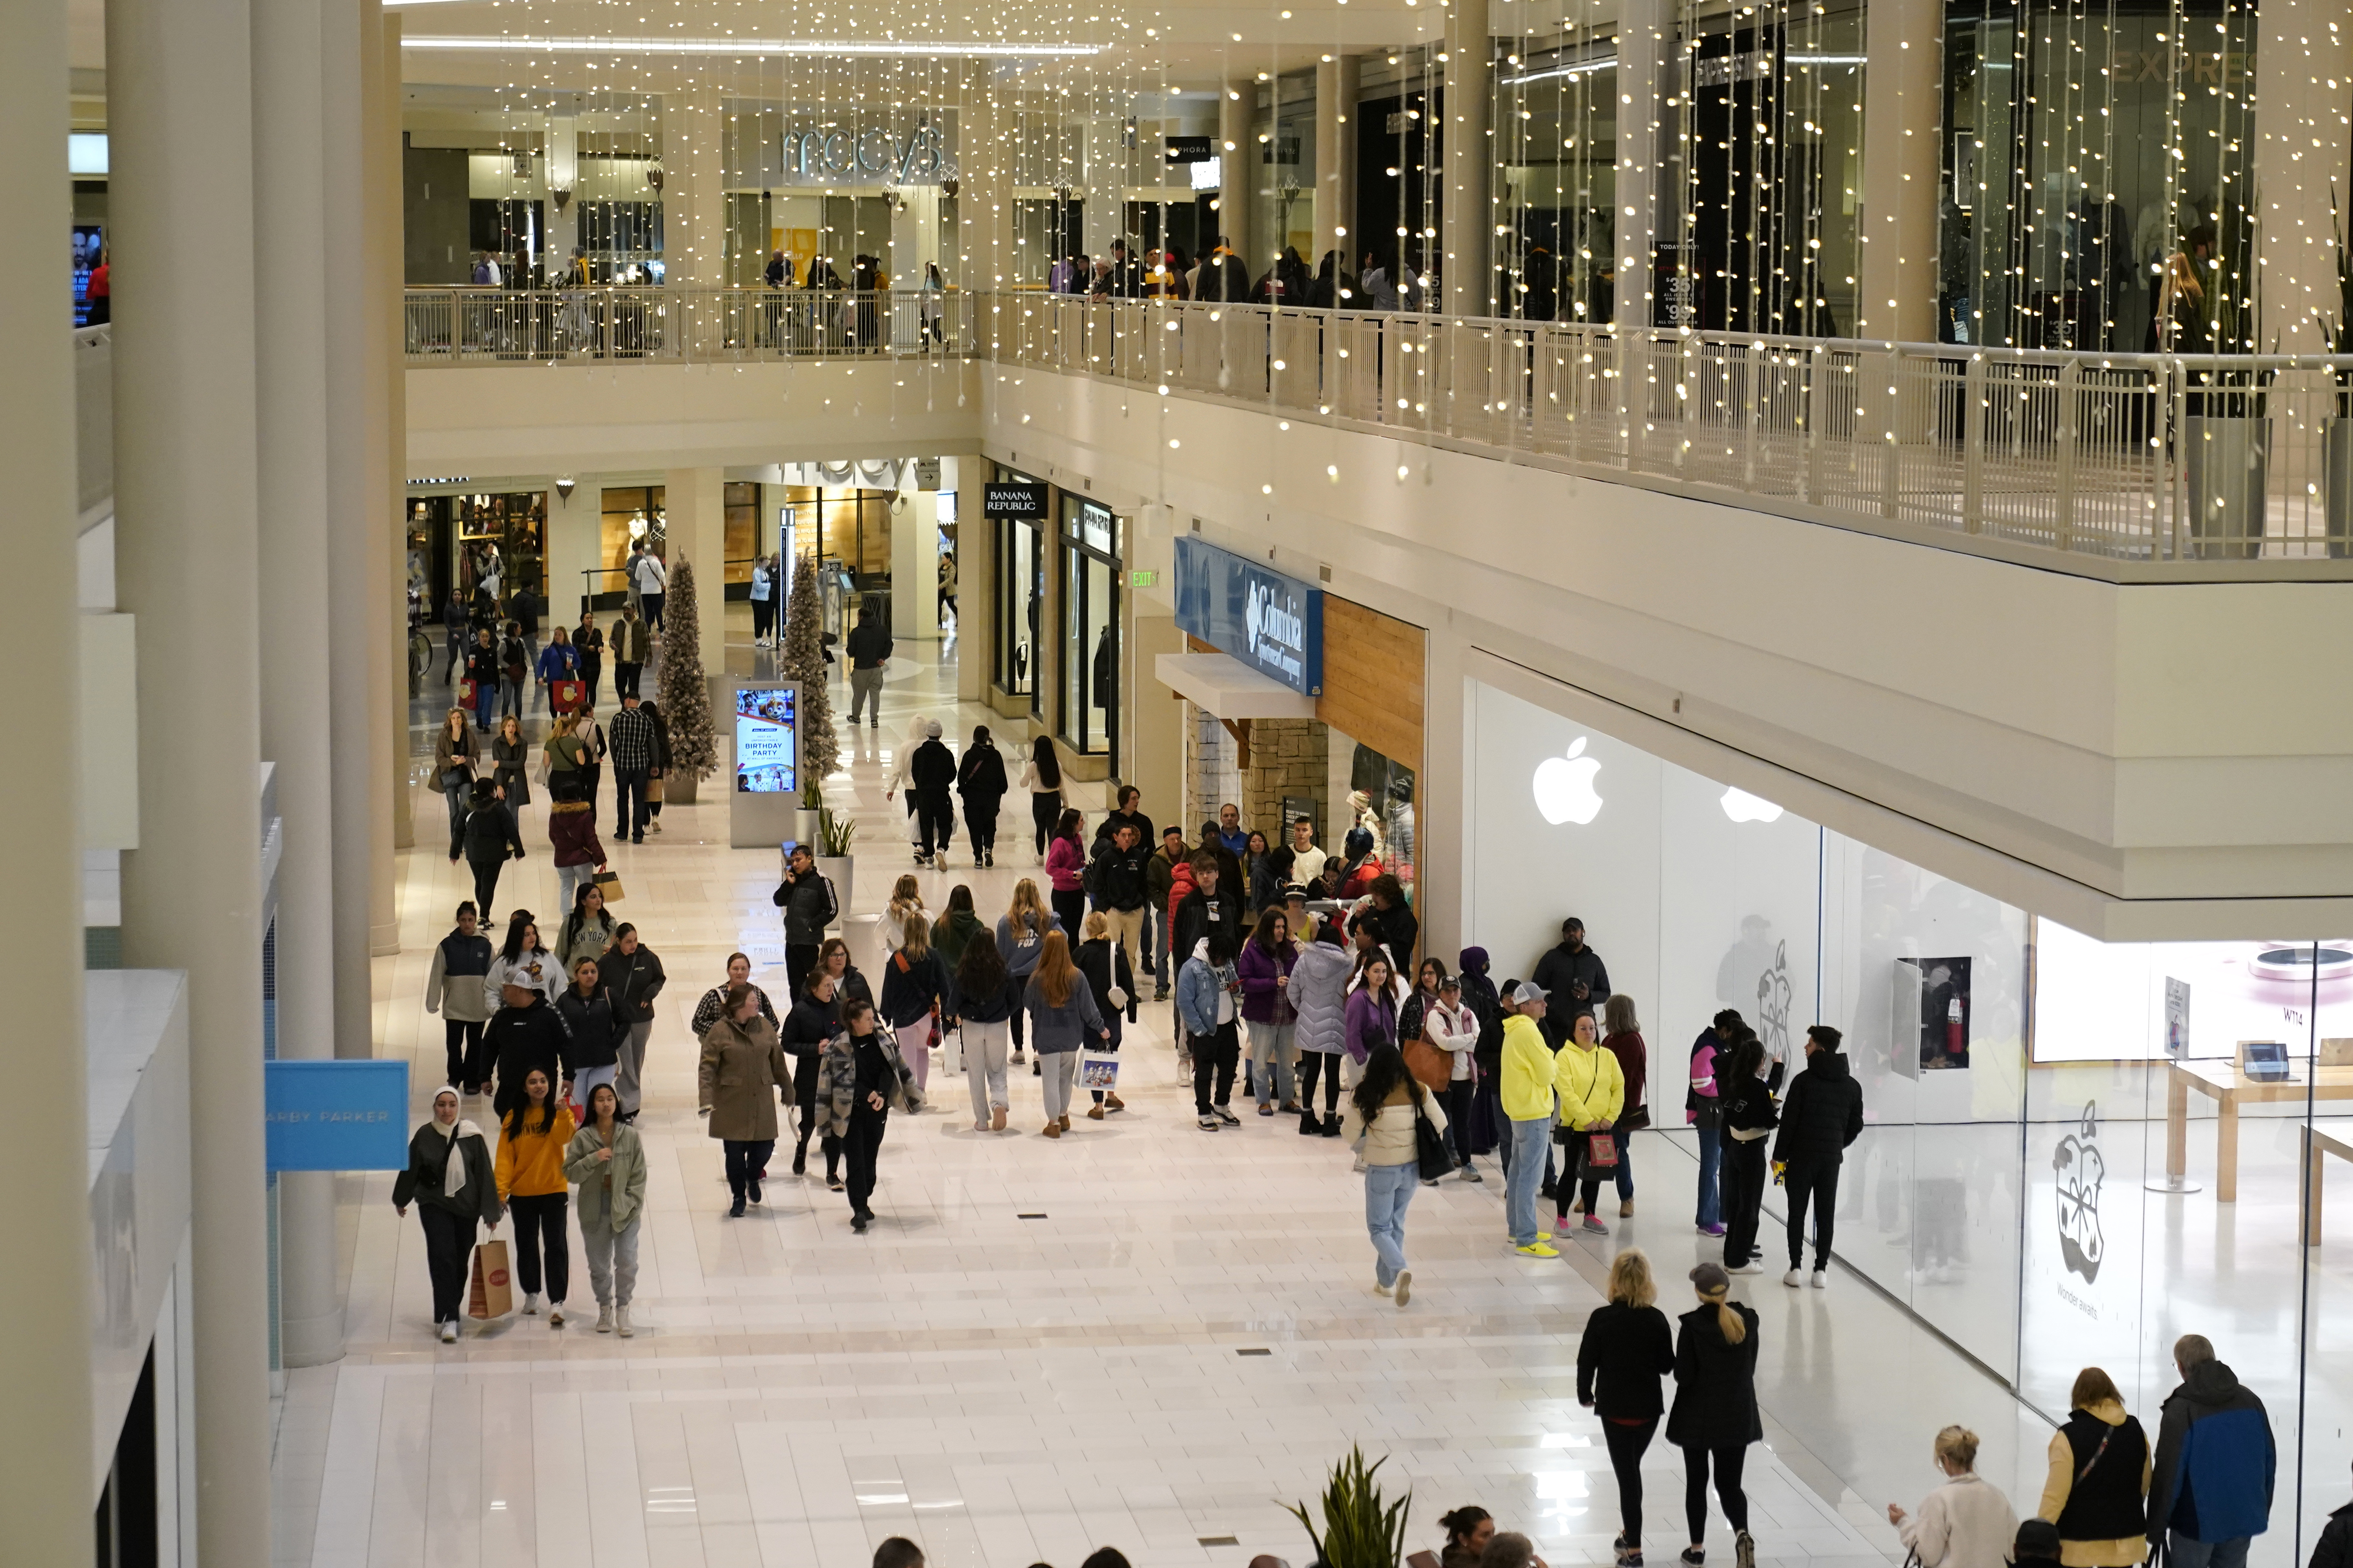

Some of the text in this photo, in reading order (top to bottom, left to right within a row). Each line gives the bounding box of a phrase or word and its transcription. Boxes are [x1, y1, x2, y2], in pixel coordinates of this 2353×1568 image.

[1666, 277, 1691, 292] $35
[991, 491, 1032, 500] BANANA
[987, 501, 1036, 510] REPUBLIC
[1133, 572, 1152, 586] EXIT
[1258, 585, 1302, 651] Columbia
[588, 932, 608, 945] YORK
[1018, 938, 1036, 948] FOX
[320, 1111, 389, 1123] PARKER
[2057, 1281, 2078, 1307] Wonder
